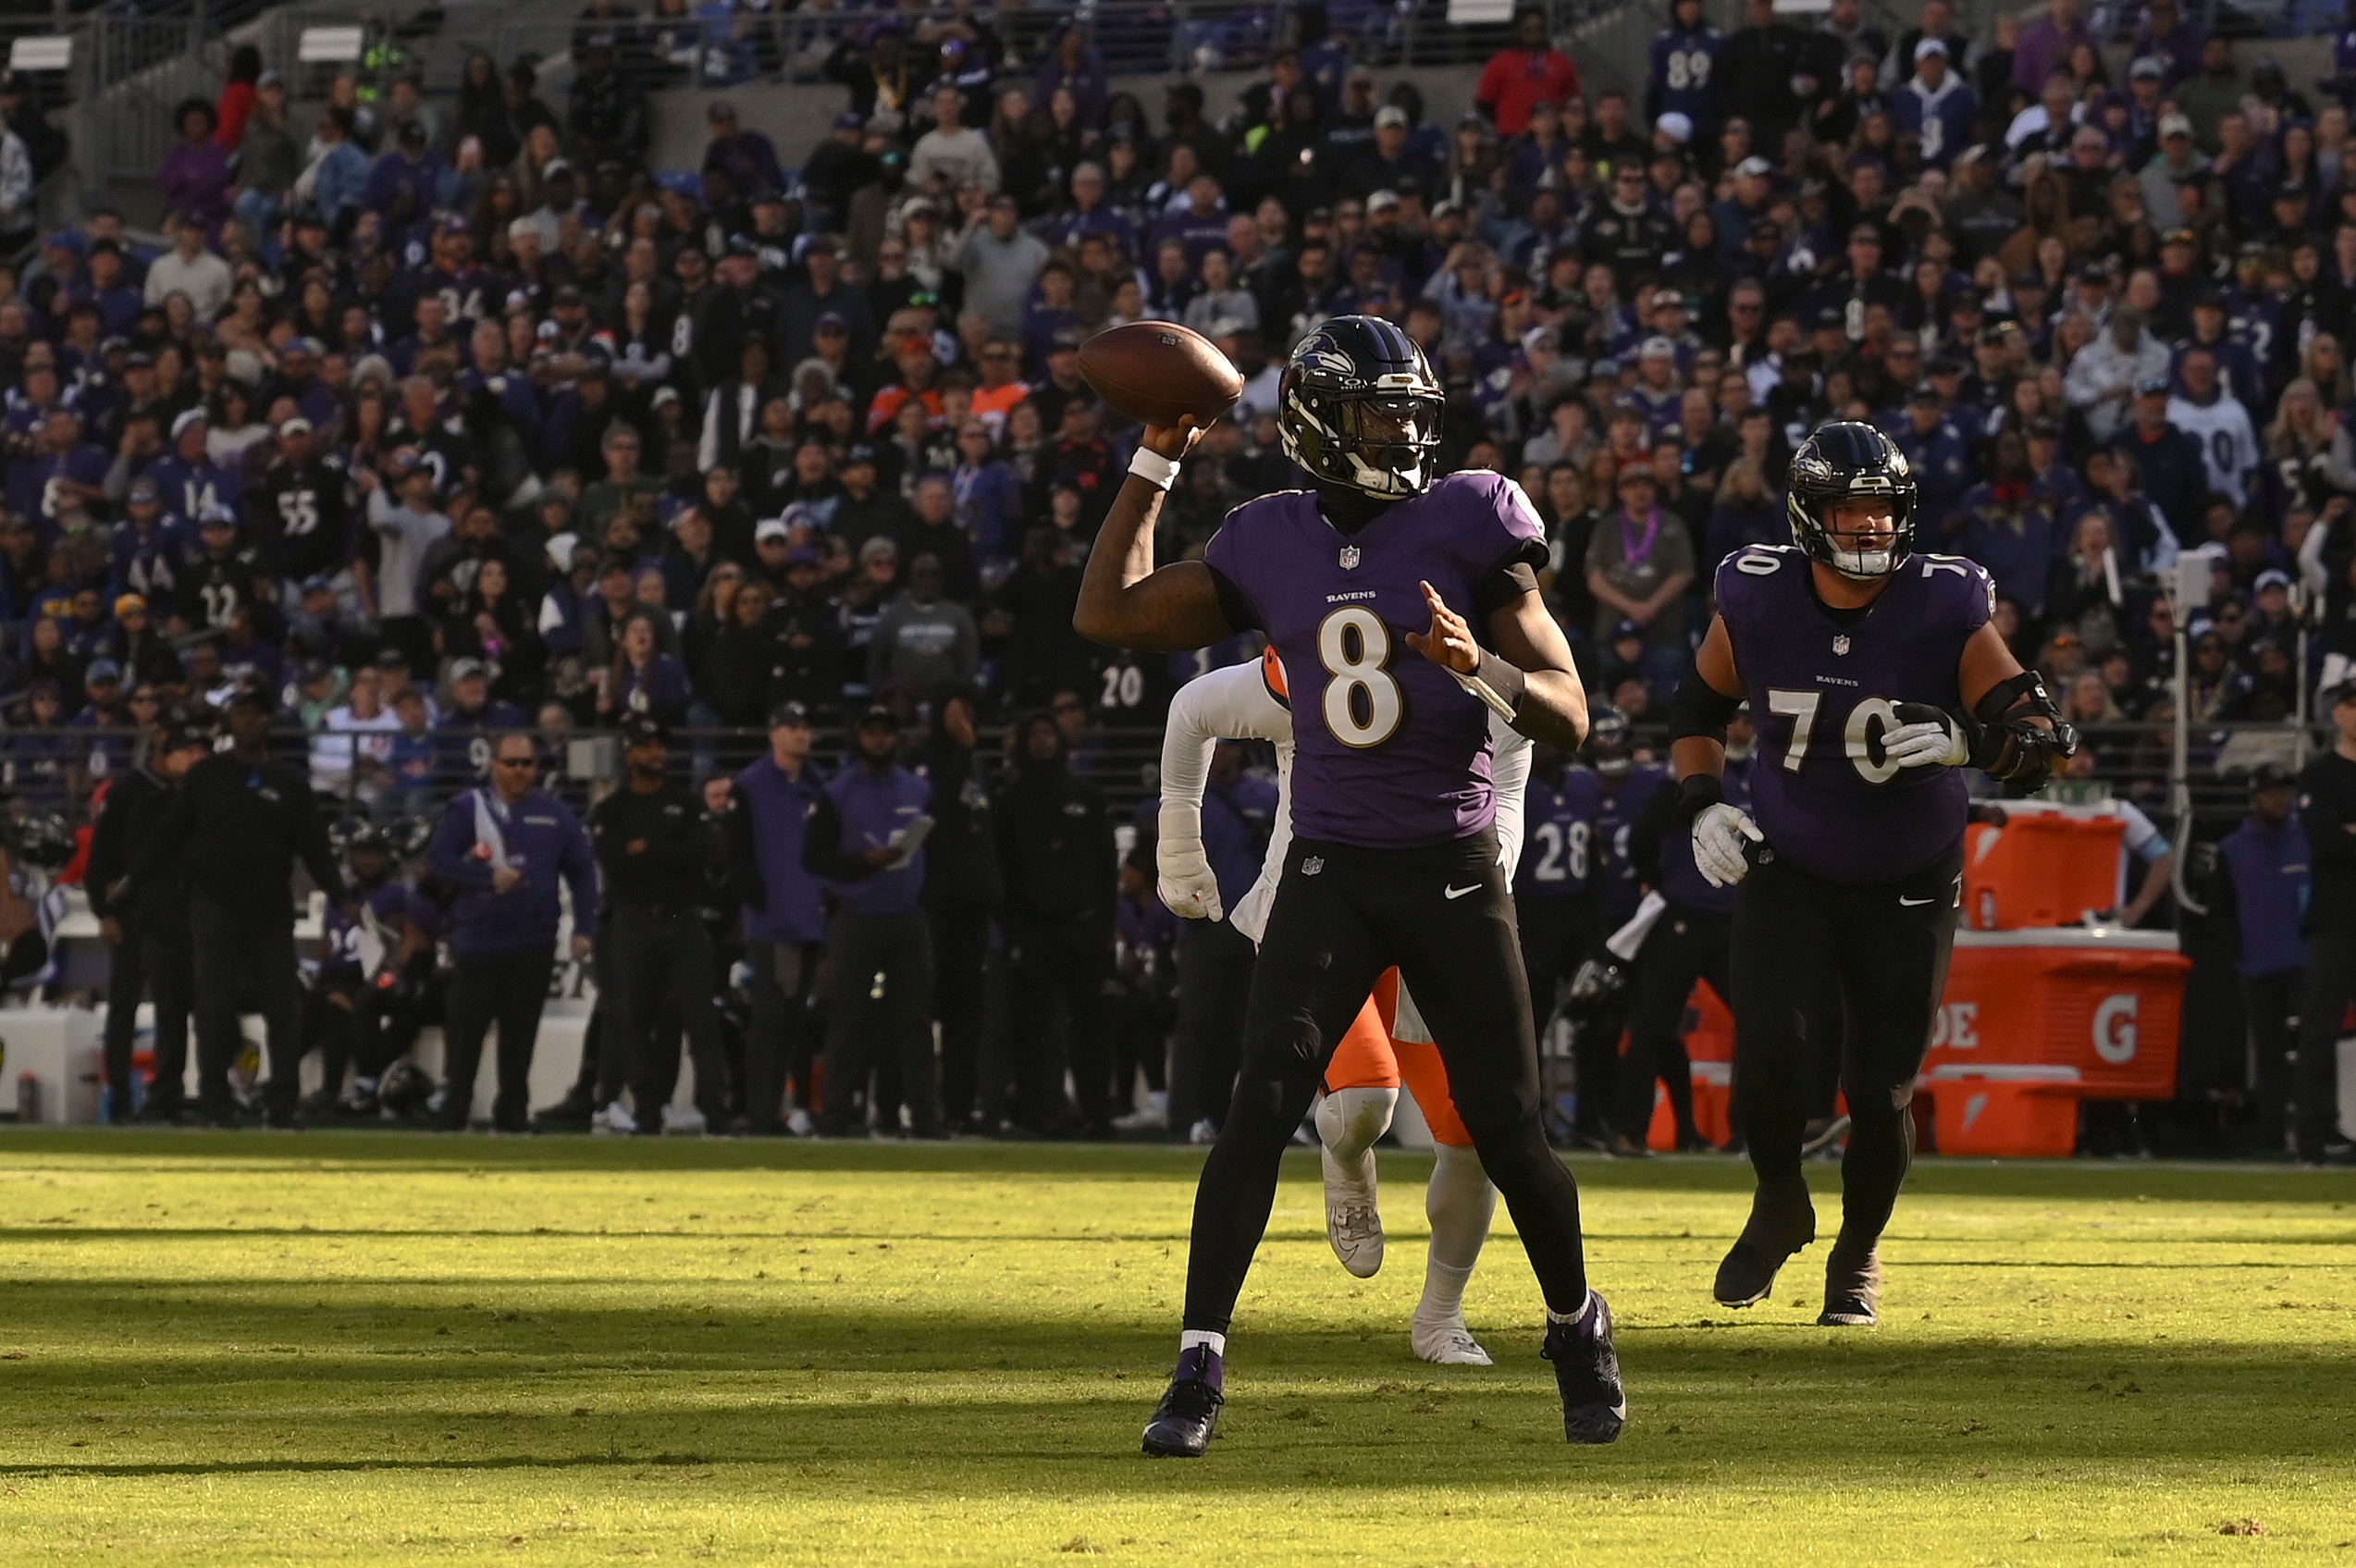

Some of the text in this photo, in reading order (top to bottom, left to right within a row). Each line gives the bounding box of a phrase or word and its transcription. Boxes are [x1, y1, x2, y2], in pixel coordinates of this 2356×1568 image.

[1666, 50, 1711, 91] 89
[278, 489, 319, 537] 55
[1325, 589, 1377, 603] RAVENS
[1100, 665, 1144, 708] 20
[1317, 605, 1404, 748] 8
[1815, 674, 1859, 687] RAVENS
[1767, 687, 1904, 784] 70
[1534, 821, 1590, 882] 28
[2092, 993, 2139, 1064] G
